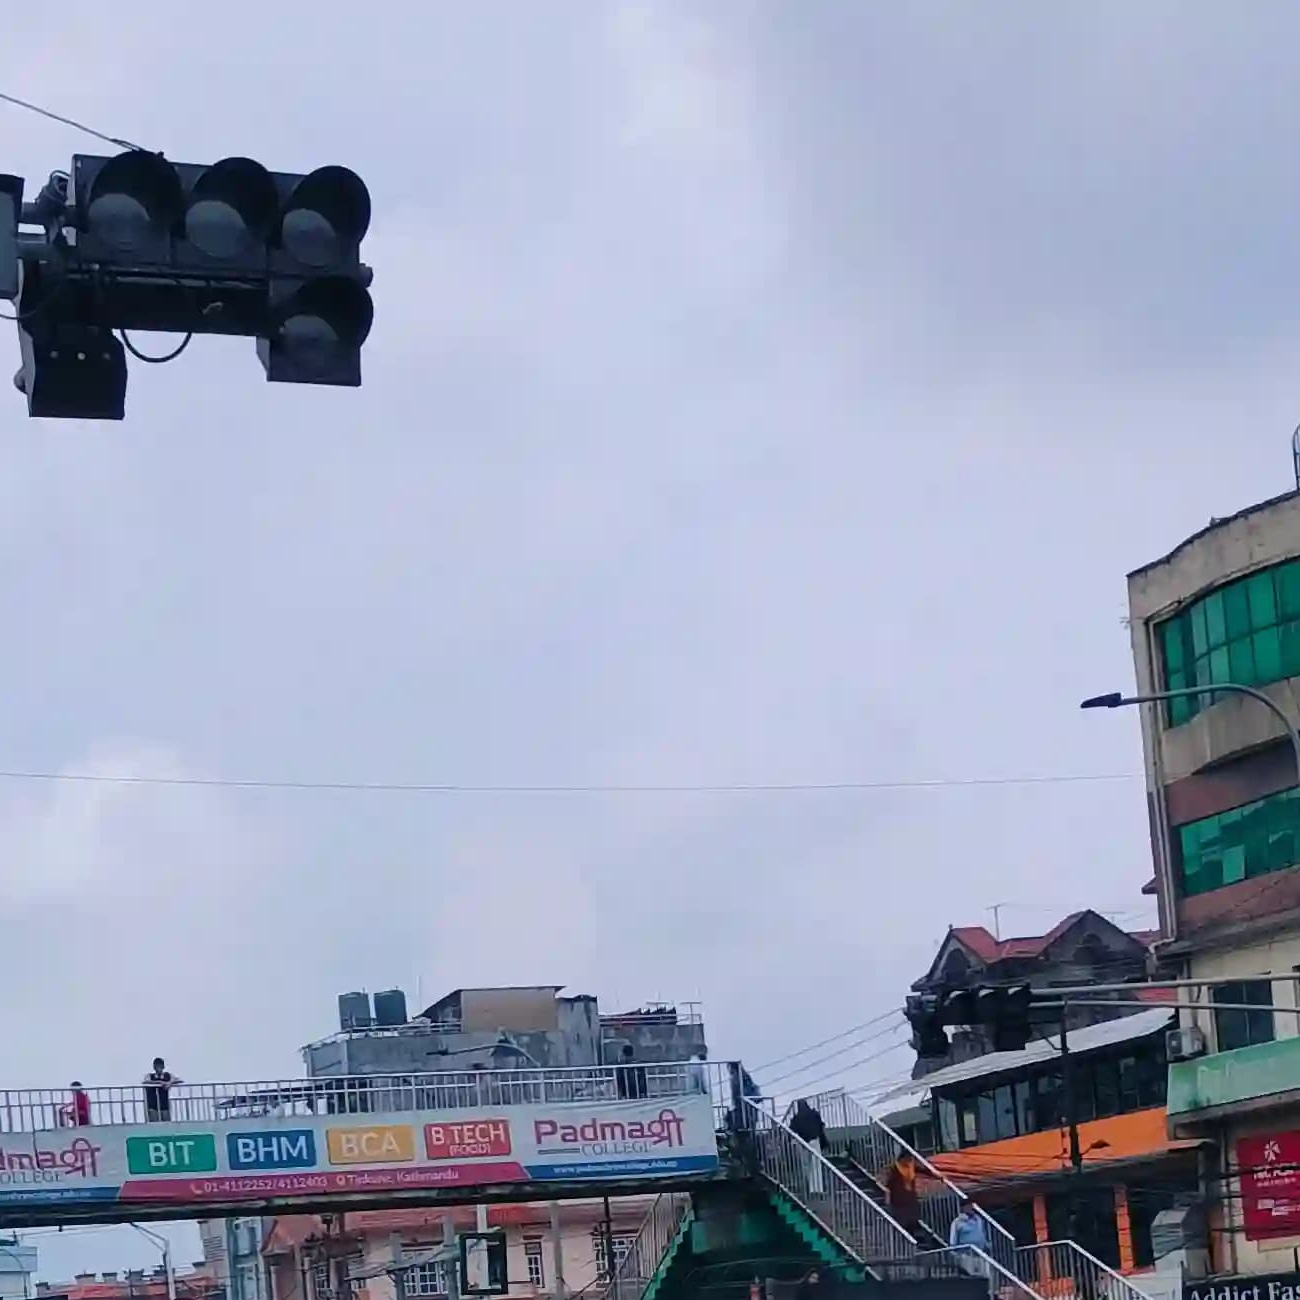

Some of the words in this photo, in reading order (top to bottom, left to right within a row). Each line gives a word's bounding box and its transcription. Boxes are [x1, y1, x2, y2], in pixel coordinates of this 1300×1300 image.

[148, 1141, 195, 1167] BIT
[237, 1135, 309, 1163] BHM
[341, 1132, 401, 1157] BCA
